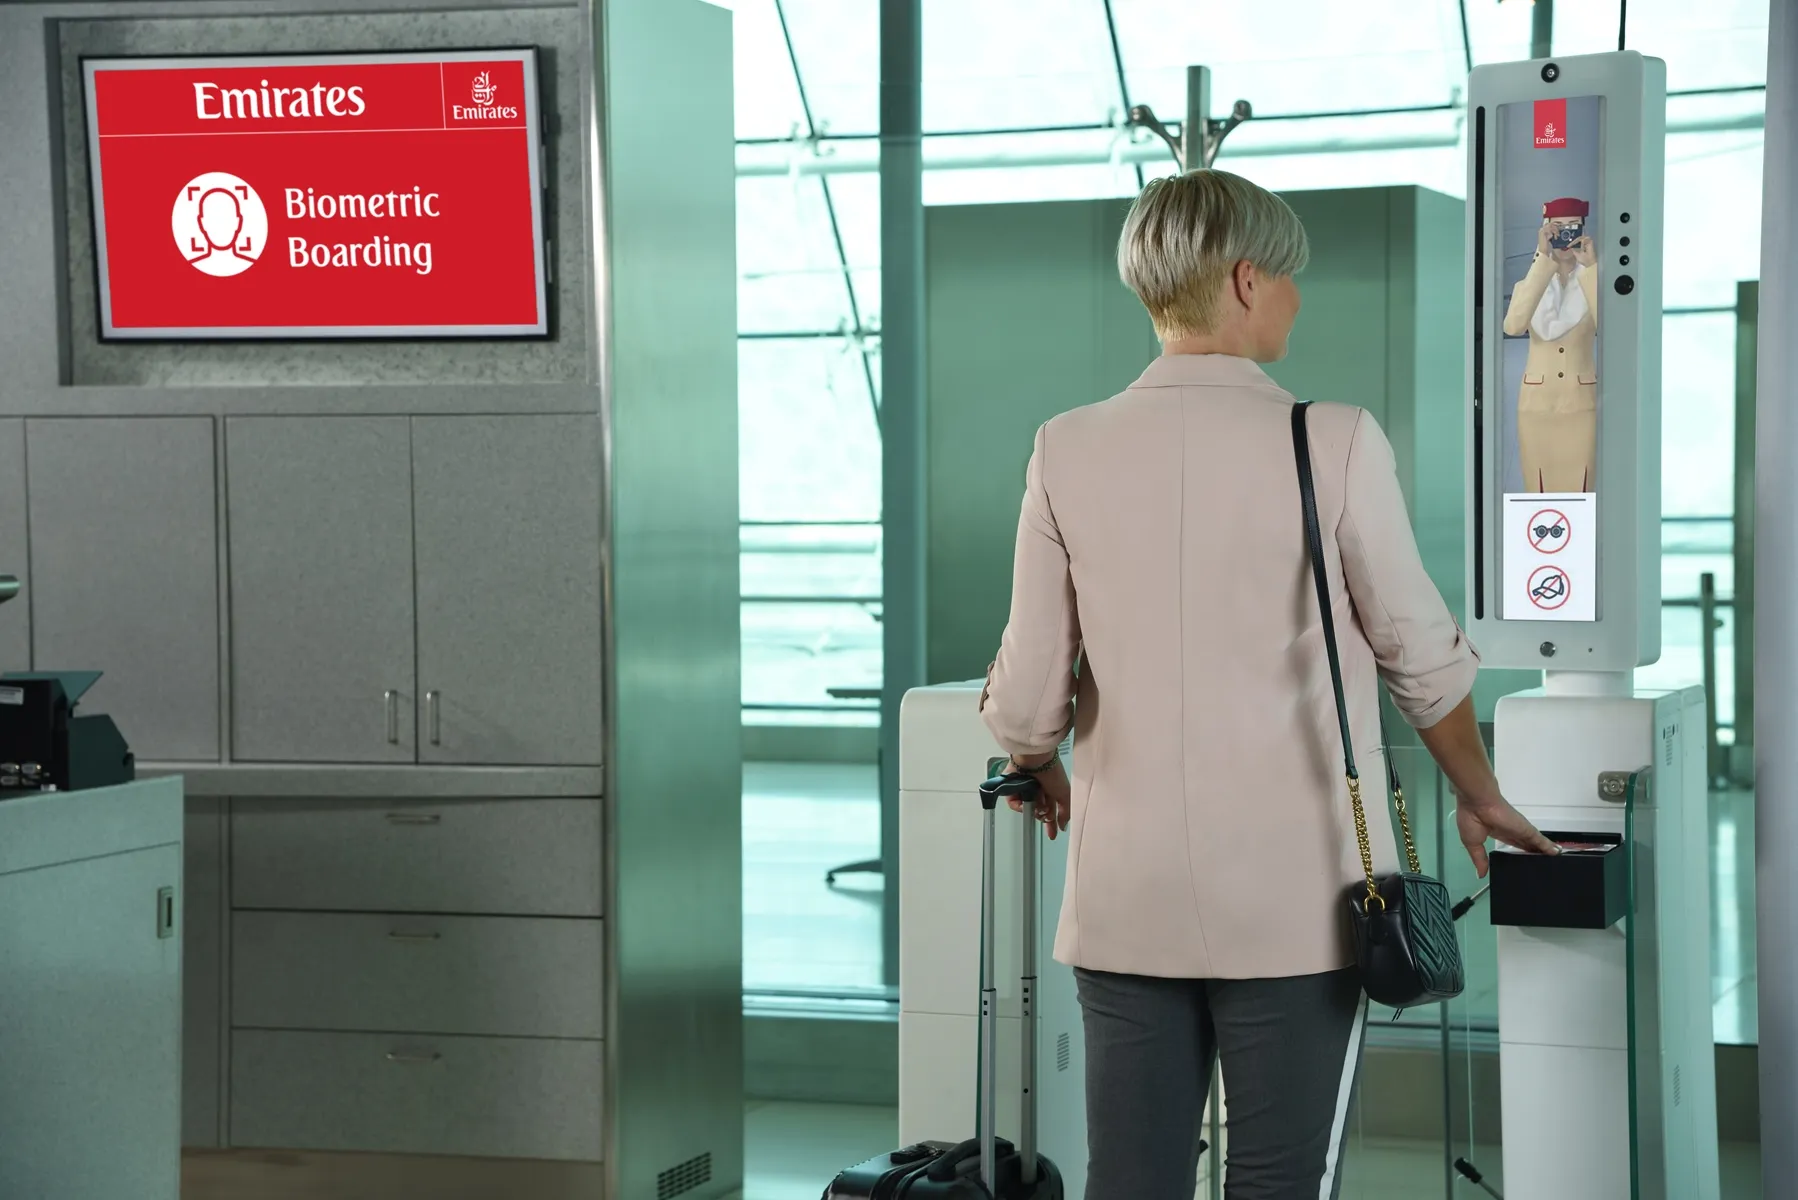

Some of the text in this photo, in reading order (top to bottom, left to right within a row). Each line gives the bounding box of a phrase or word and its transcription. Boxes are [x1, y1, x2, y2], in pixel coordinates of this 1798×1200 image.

[192, 79, 366, 120] Emirates
[452, 104, 518, 120] Emirates
[1535, 136, 1565, 144] Emirates
[284, 185, 441, 219] Biometric
[287, 235, 433, 275] Boarding
